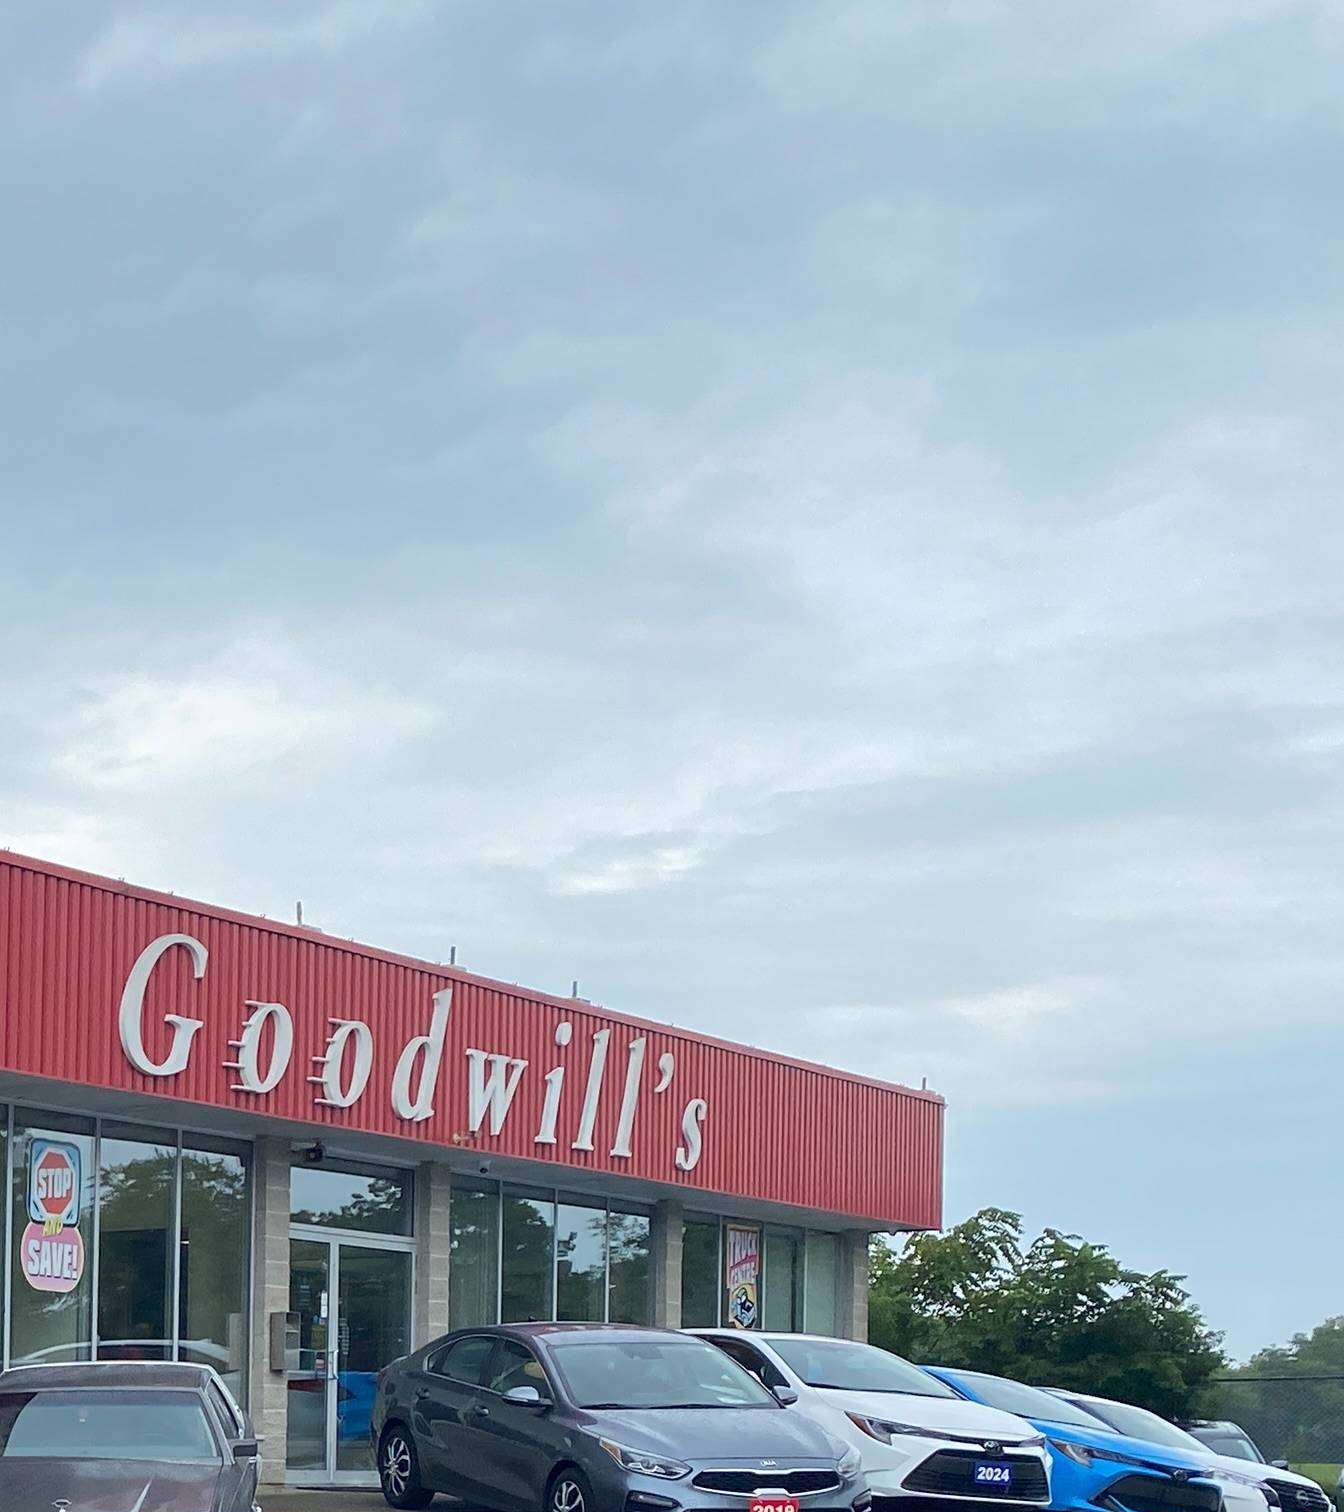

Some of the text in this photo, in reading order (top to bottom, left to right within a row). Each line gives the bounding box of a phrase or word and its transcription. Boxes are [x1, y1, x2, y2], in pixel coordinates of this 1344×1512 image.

[119, 933, 708, 1172] Goodwill's
[38, 1168, 72, 1200] STOP
[43, 1217, 63, 1237] AND
[27, 1239, 78, 1281] SAVE!
[977, 1466, 1010, 1482] 2024
